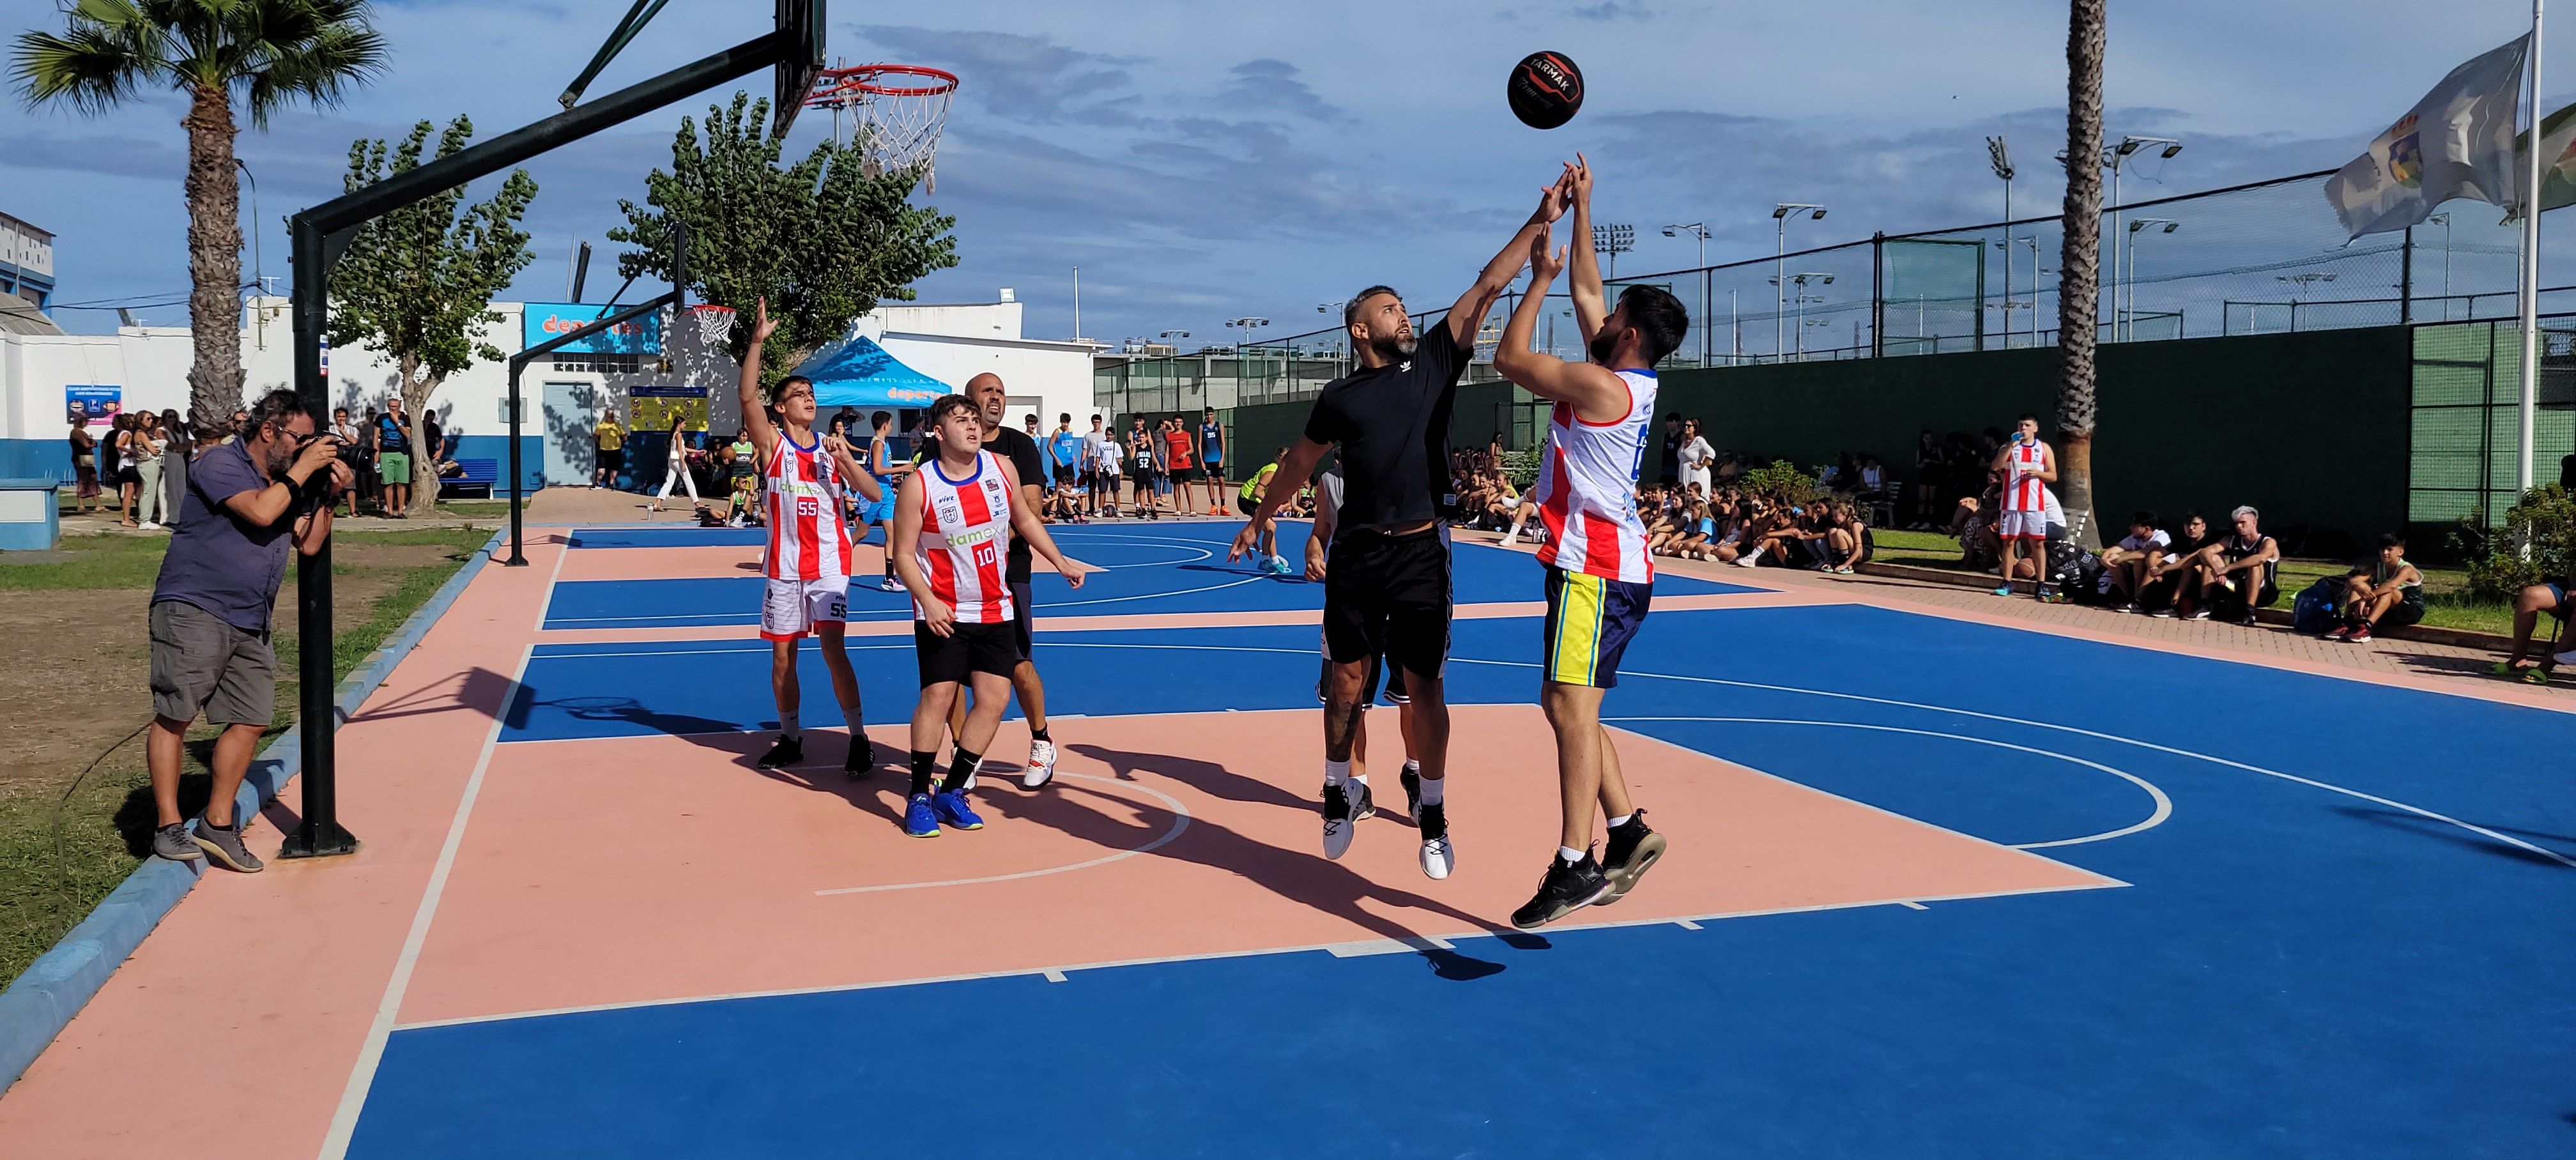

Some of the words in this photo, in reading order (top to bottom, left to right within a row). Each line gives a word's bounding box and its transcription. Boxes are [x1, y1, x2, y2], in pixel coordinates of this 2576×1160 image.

[1531, 59, 1570, 91] TARMAK
[1139, 458, 1149, 468] 52
[939, 495, 954, 504] vive
[798, 501, 817, 515] 55
[976, 547, 995, 567] 10
[831, 602, 847, 618] 55
